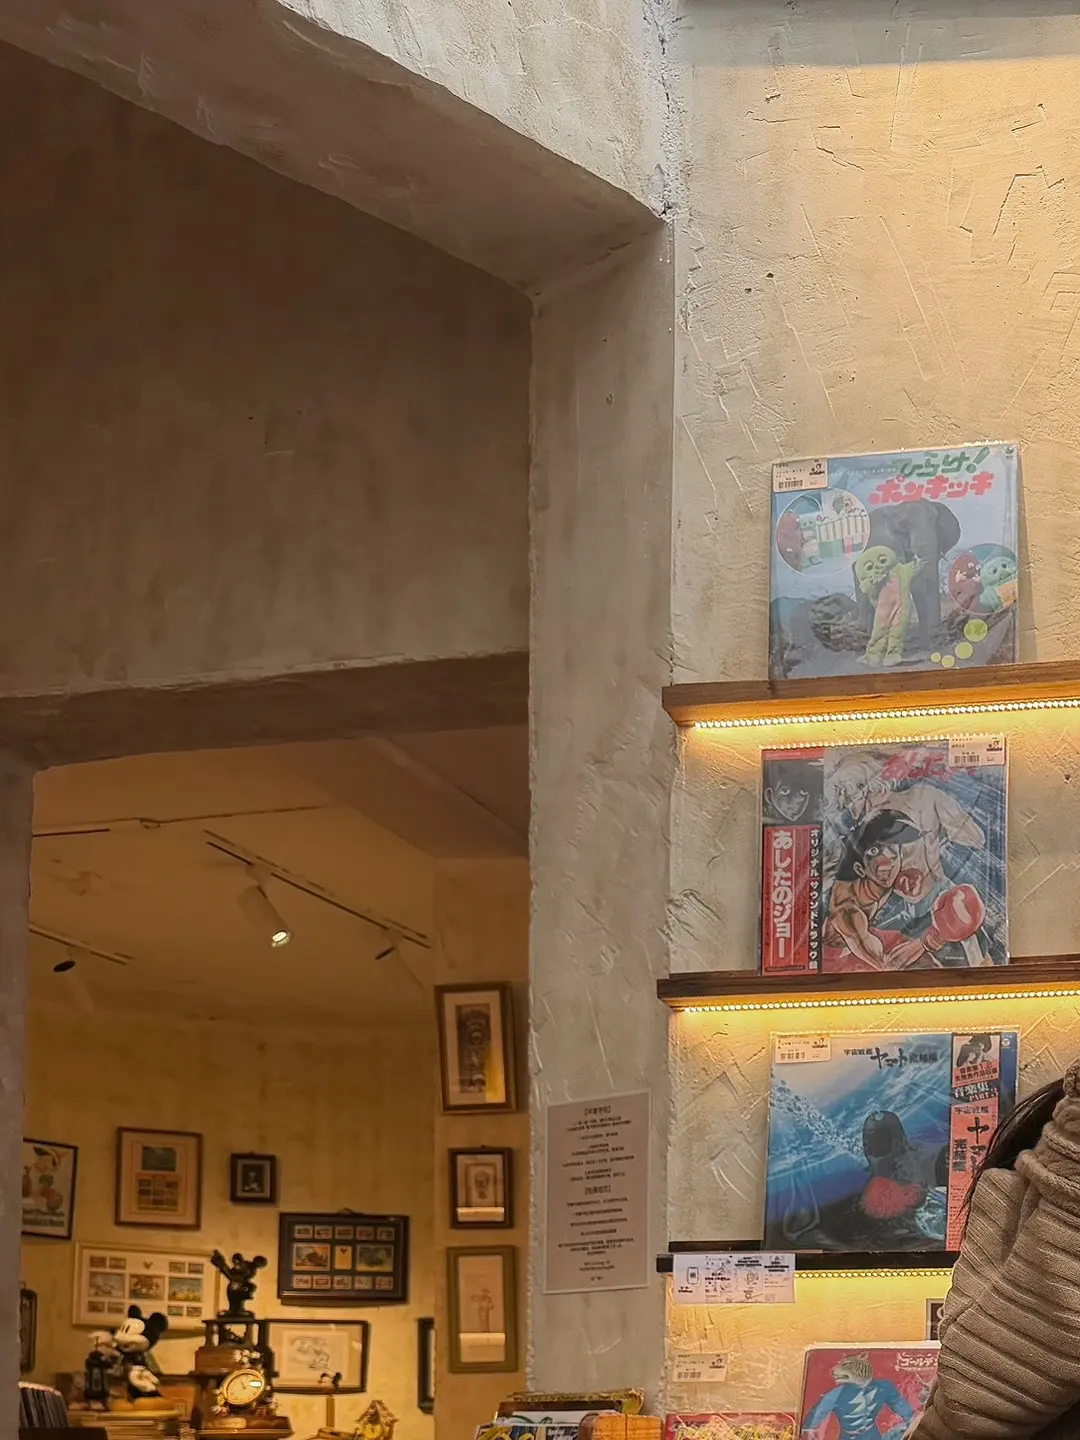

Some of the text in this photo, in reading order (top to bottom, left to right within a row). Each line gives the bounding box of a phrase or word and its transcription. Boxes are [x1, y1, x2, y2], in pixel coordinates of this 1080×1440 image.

[868, 471, 995, 505] ポンキッキ
[809, 829, 821, 877] オリジナル
[772, 830, 795, 958] あしたのジョー
